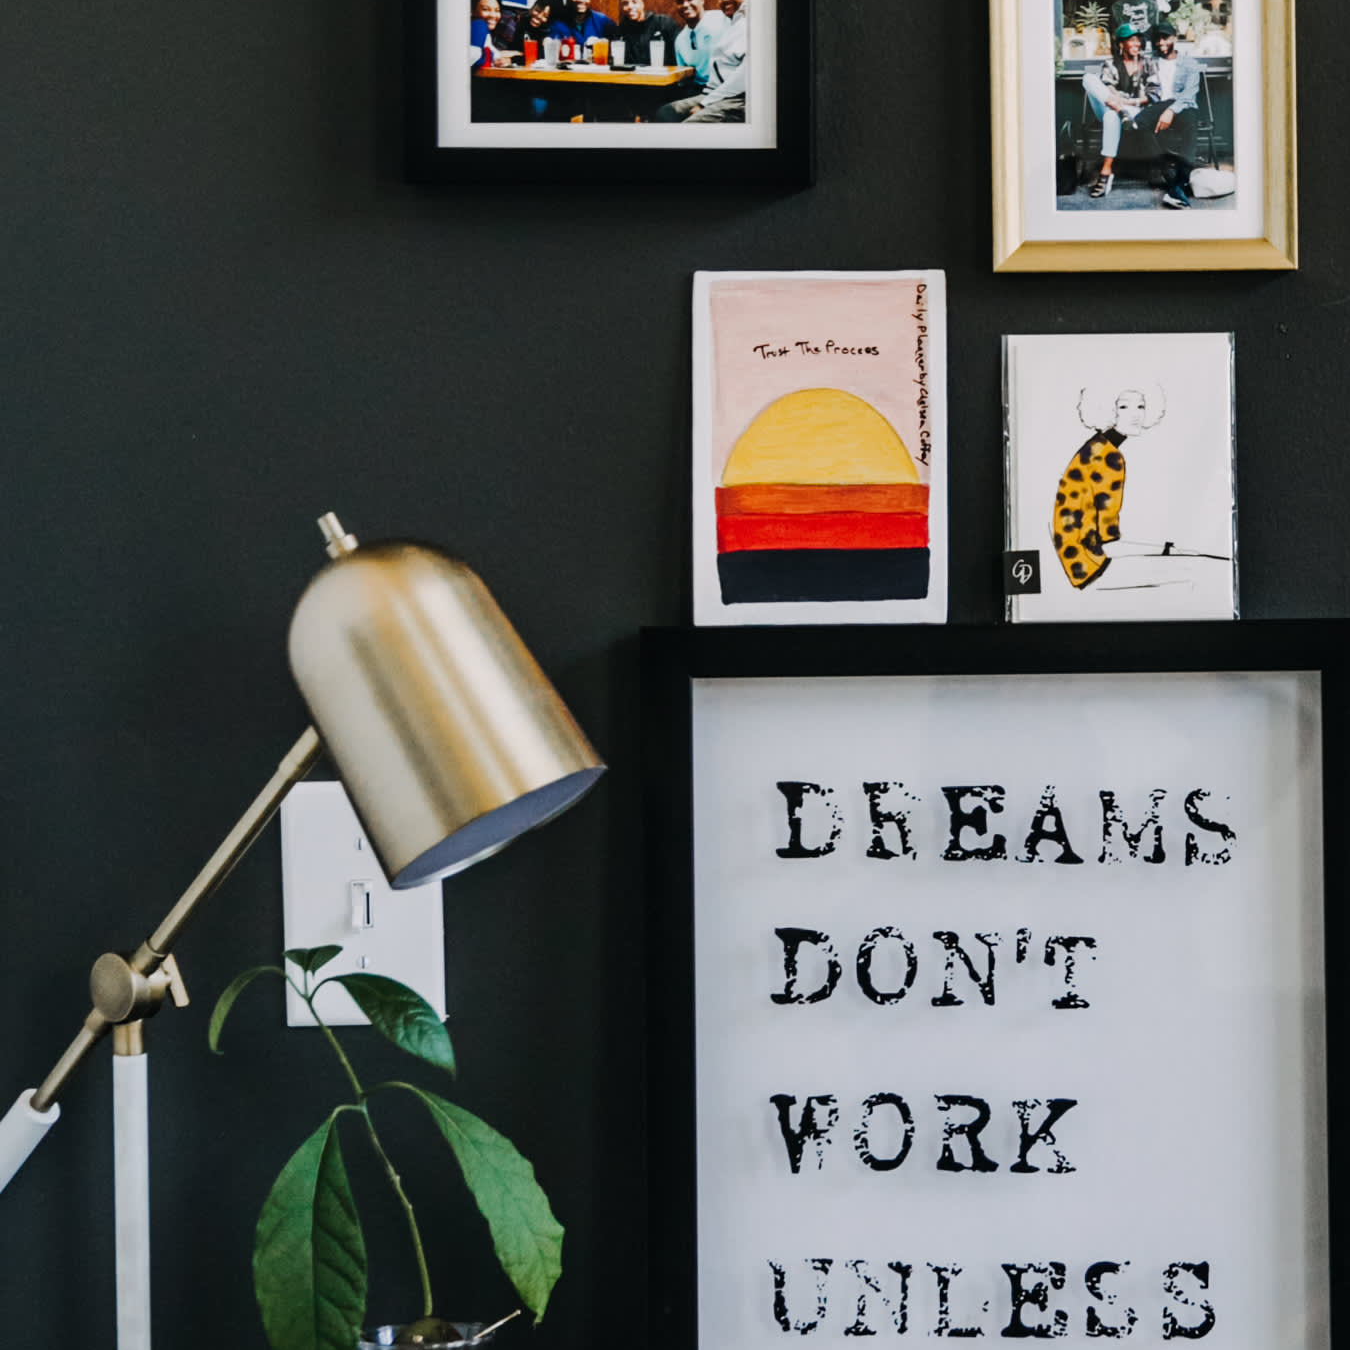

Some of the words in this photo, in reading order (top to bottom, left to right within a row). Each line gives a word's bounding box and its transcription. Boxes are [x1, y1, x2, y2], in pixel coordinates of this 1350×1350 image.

[753, 343, 790, 359] Trust
[795, 340, 821, 355] The
[825, 339, 880, 356] Process
[775, 781, 1238, 867] DREAMS
[769, 925, 1097, 1010] DON'T
[769, 1092, 1078, 1175] WORK
[768, 1258, 1217, 1341] UNLESS
